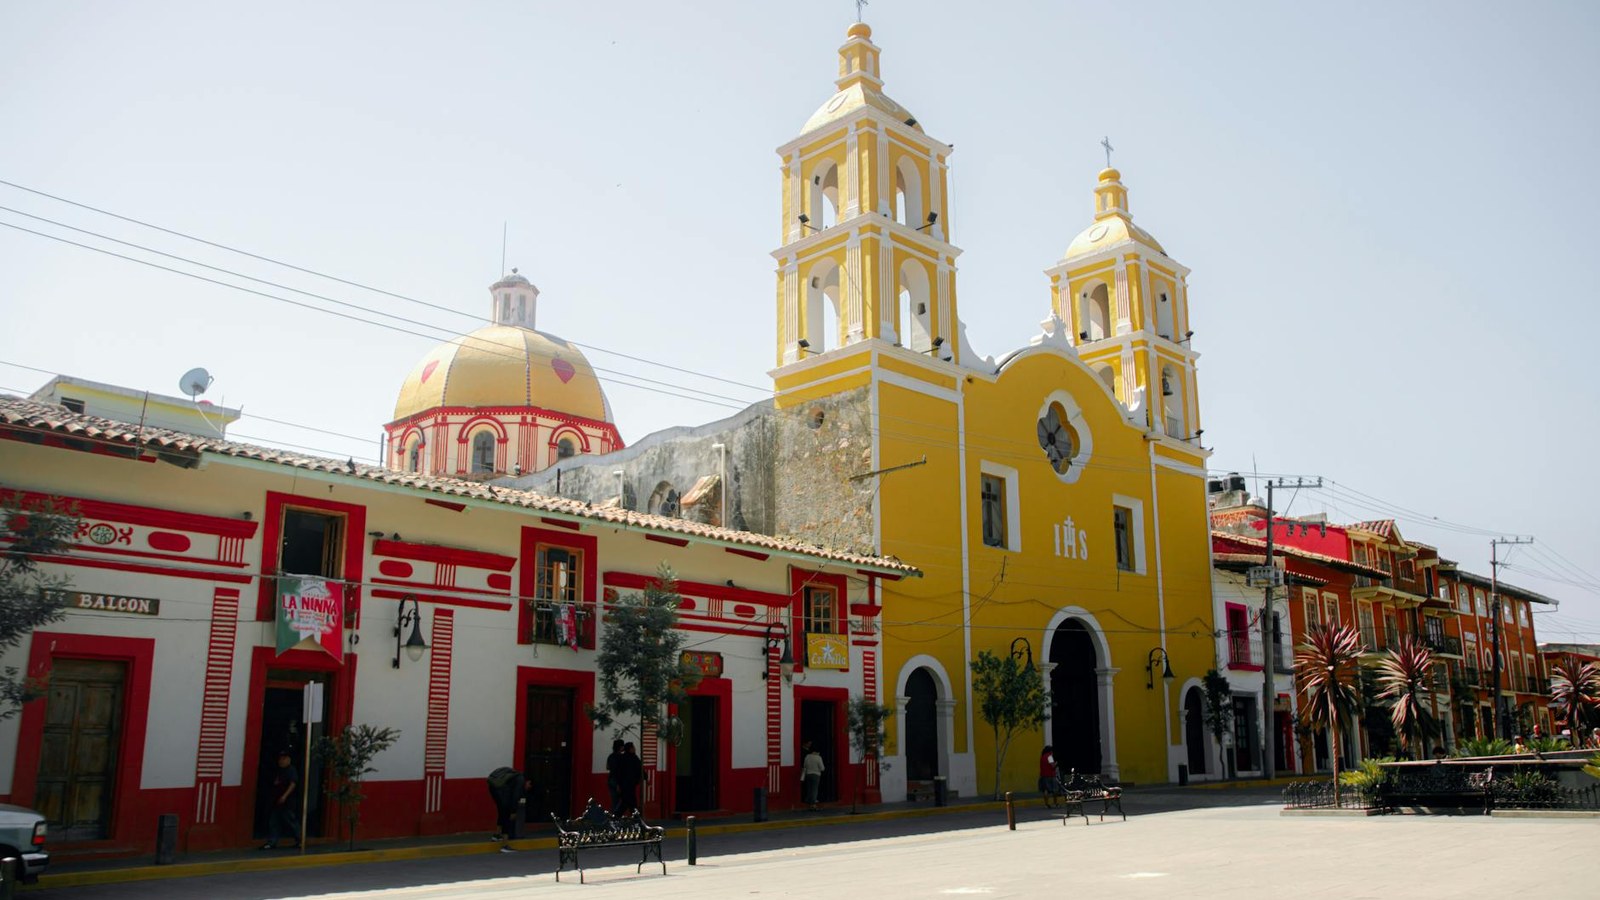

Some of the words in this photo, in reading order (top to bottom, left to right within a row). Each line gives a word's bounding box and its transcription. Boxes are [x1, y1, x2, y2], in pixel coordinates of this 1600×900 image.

[79, 593, 151, 613] BALCON
[282, 594, 297, 609] LA
[301, 596, 336, 615] NINNA
